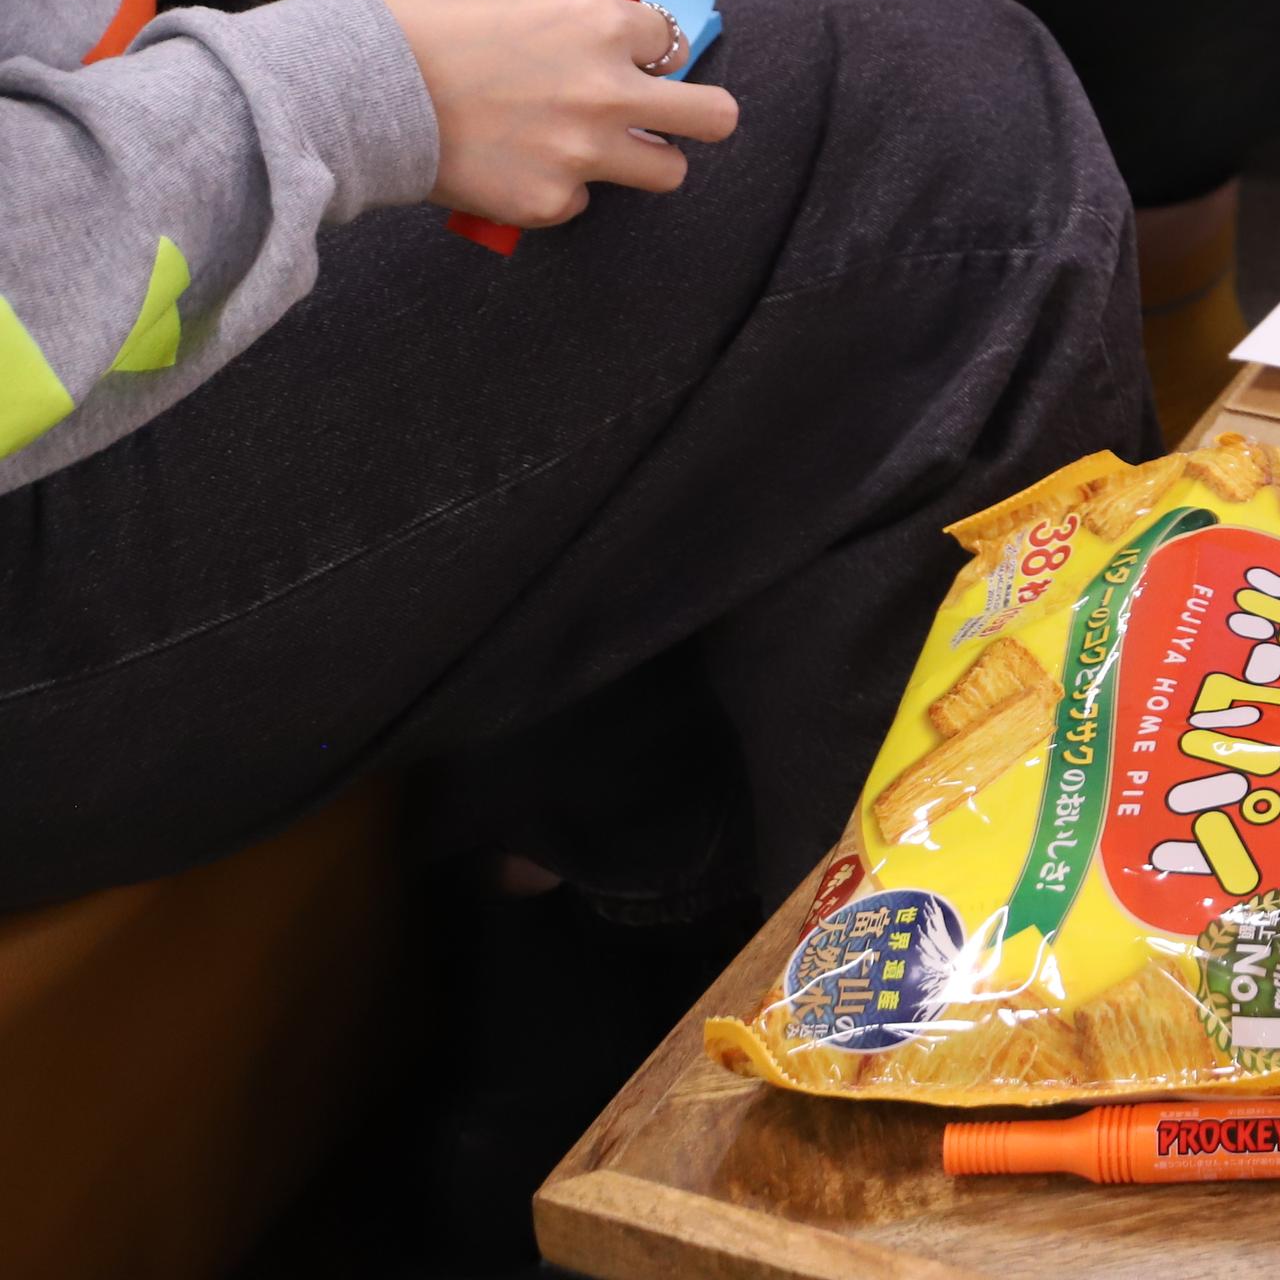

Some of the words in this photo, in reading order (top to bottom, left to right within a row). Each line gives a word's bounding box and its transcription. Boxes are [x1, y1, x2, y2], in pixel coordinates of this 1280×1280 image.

[1163, 584, 1214, 664] FUJIYA
[1133, 677, 1177, 753] HOME
[1117, 770, 1150, 817] PIE
[877, 906, 919, 1012] 世界遺産
